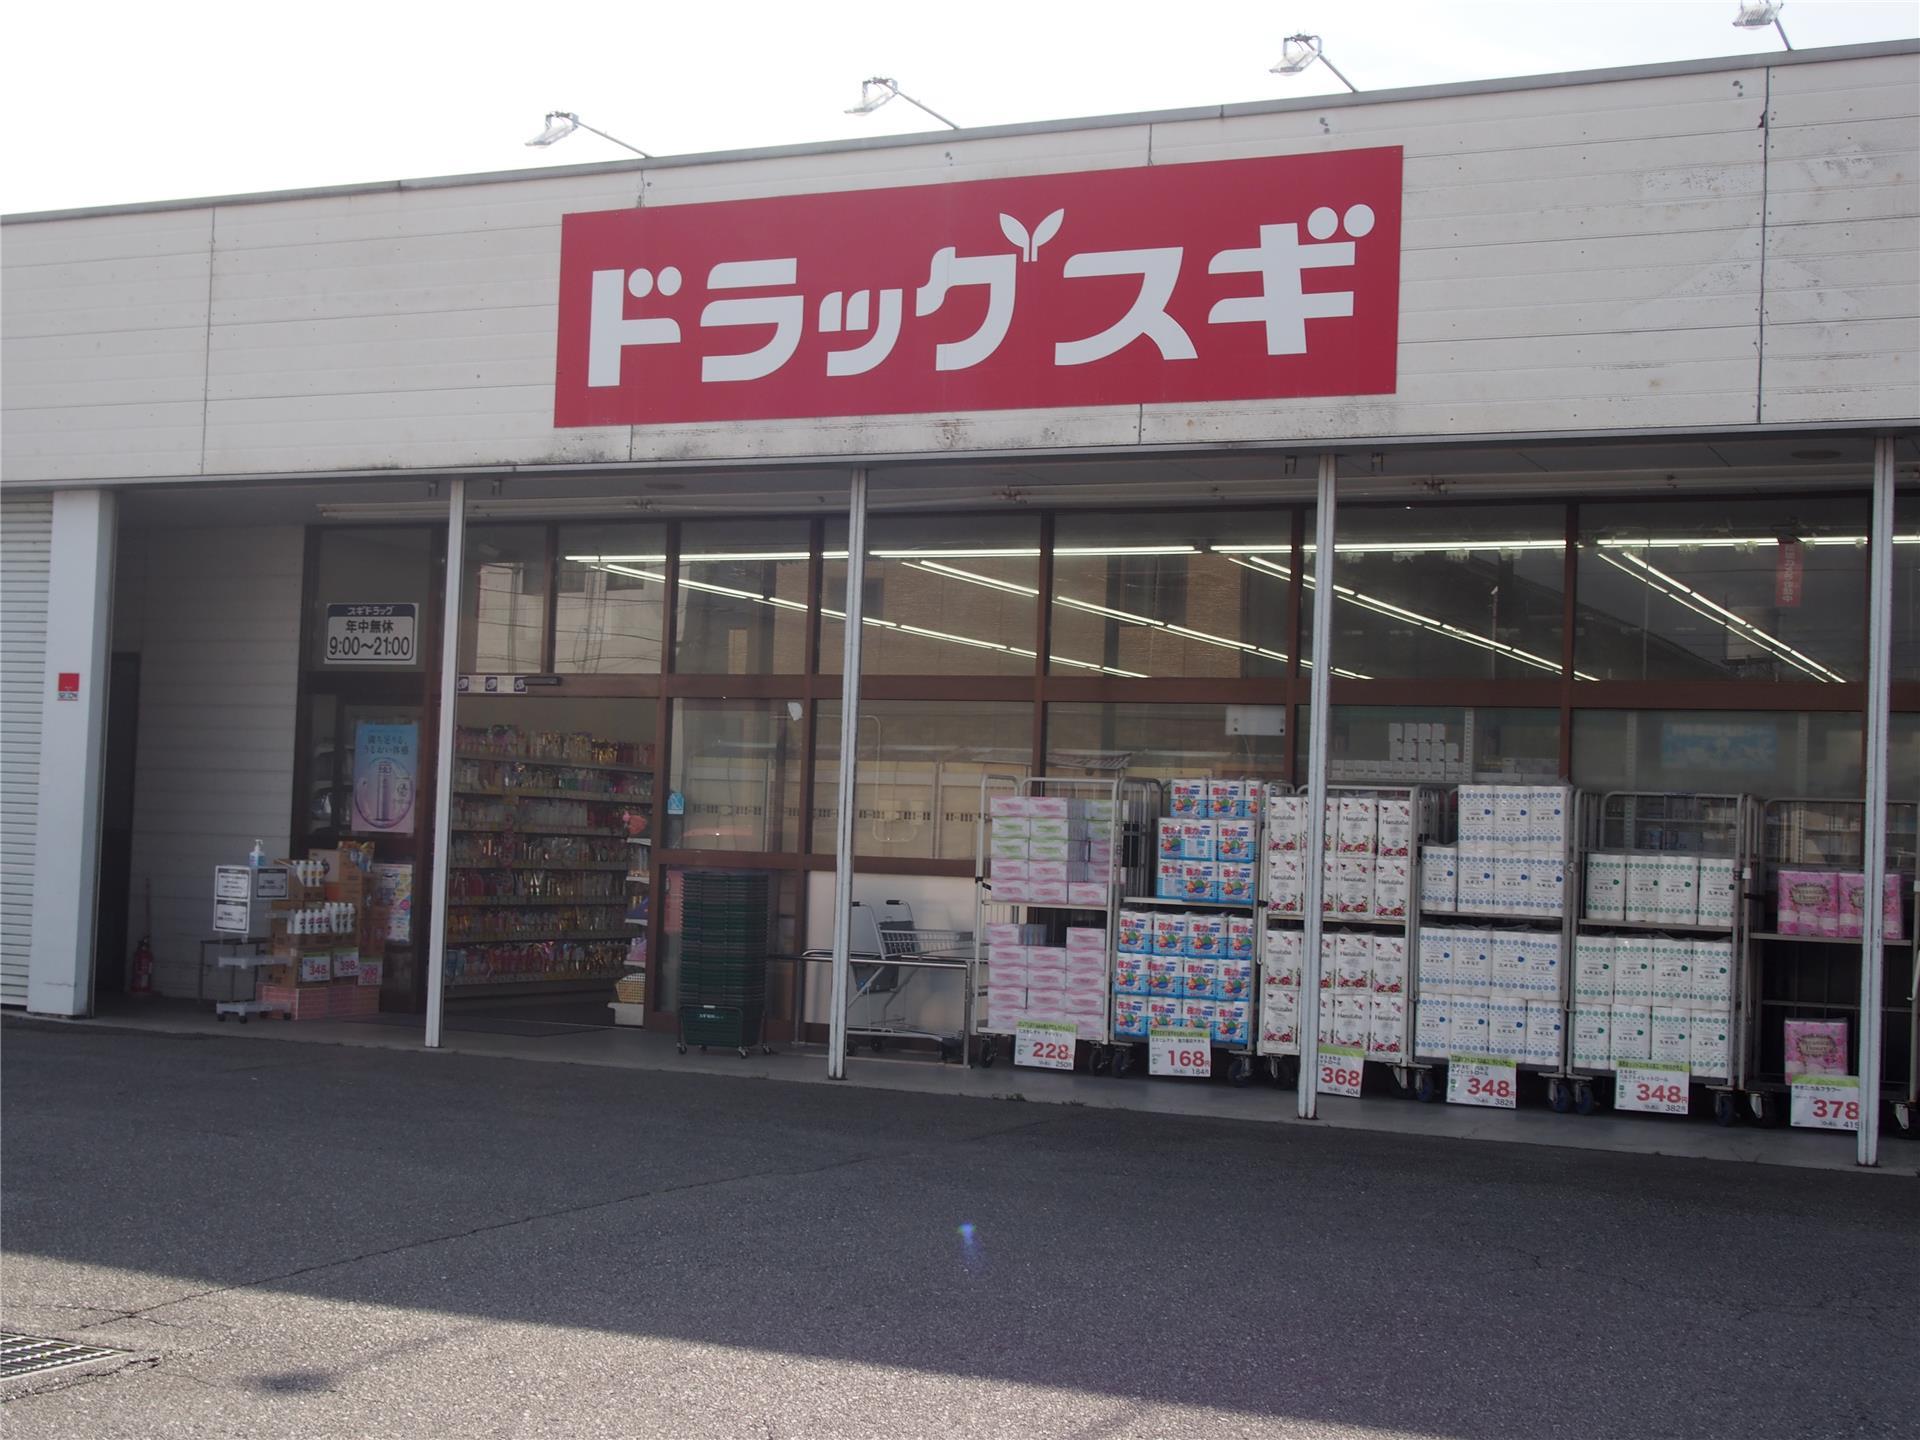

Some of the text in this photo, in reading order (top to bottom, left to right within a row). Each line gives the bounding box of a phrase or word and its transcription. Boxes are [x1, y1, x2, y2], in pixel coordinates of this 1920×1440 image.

[588, 204, 1375, 387] ドラッグスギ
[345, 619, 394, 634] 年中無休
[1321, 1067, 1359, 1086] 368
[1813, 1100, 1859, 1119] 378
